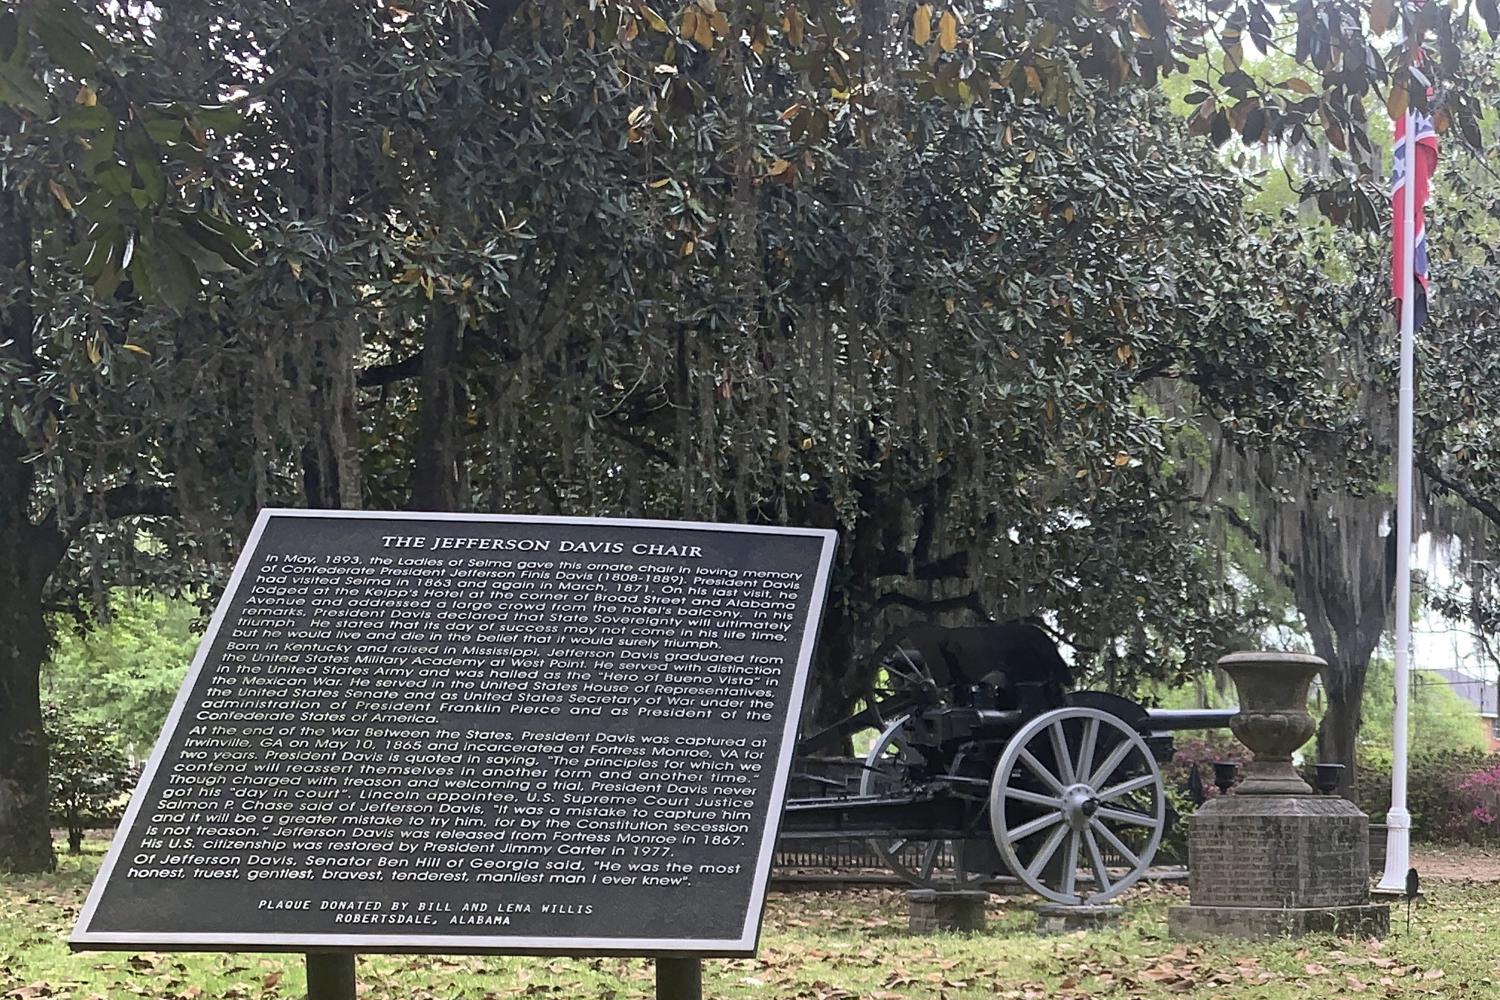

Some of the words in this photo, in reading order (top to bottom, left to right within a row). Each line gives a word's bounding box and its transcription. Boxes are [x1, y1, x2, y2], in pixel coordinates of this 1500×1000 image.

[382, 535, 426, 548] THE
[431, 537, 550, 551] JEFFERSON
[558, 540, 624, 554] DAVIS
[632, 543, 702, 557] CHAIR
[260, 564, 278, 573] of
[281, 564, 375, 575] Confederate
[380, 566, 446, 577] President
[449, 568, 516, 578] Jefferson
[520, 570, 551, 580] Finis
[555, 571, 593, 581] Davis
[693, 576, 758, 587] President
[762, 579, 800, 590] Davis
[265, 554, 279, 562] In
[369, 556, 393, 566] the
[398, 557, 444, 567] Ladies
[448, 558, 464, 567] of
[467, 558, 513, 568] Selma
[517, 561, 554, 572] gave
[559, 561, 582, 570] this
[586, 563, 634, 572] ornate
[638, 564, 675, 573] chair
[678, 565, 692, 575] in
[695, 566, 738, 578] loving
[742, 570, 803, 581] memory
[226, 641, 260, 651] Born
[264, 642, 279, 651] in
[284, 642, 353, 653] Kentucky
[356, 644, 388, 653] and
[392, 645, 440, 654] raised
[443, 645, 457, 655] in
[547, 648, 615, 658] Jefferson
[620, 649, 660, 660] Davis
[664, 652, 745, 664] graduated
[749, 654, 784, 664] from
[222, 653, 247, 662] the
[251, 653, 301, 663] United
[304, 653, 350, 664] States
[354, 655, 408, 666] Military
[411, 656, 486, 668] Academy
[489, 658, 506, 667] at
[511, 658, 545, 668] West
[593, 660, 614, 670] He
[618, 662, 669, 671] served
[673, 663, 702, 672] with
[706, 664, 781, 675] distinction
[196, 710, 295, 721] Confederate
[300, 711, 346, 722] States
[350, 712, 368, 722] of
[201, 699, 320, 709] administration
[329, 700, 348, 710] of
[355, 700, 431, 711] President
[439, 702, 501, 713] Franklin
[510, 704, 561, 714] Pierce
[569, 706, 602, 715] and
[610, 707, 629, 716] as
[638, 707, 712, 718] President
[720, 710, 737, 719] of
[746, 710, 772, 721] the
[188, 725, 208, 735] At
[211, 725, 237, 735] the
[242, 726, 275, 736] end
[278, 726, 297, 736] of
[300, 726, 325, 737] the
[331, 726, 360, 737] War
[364, 727, 430, 738] Between
[435, 729, 461, 739] the
[521, 731, 590, 742] President
[595, 732, 636, 743] Davis
[641, 735, 670, 744] was
[675, 736, 746, 747] captured
[750, 738, 767, 748] at
[145, 825, 159, 836] is
[162, 825, 191, 836] not
[272, 826, 346, 837] Jefferson
[352, 827, 395, 838] Davis
[400, 830, 431, 839] was
[435, 829, 506, 840] released
[510, 830, 547, 841] from
[552, 831, 611, 843] Fortress
[616, 833, 677, 844] Monroe
[682, 834, 696, 845] in
[140, 838, 164, 849] His
[202, 839, 286, 851] citizenship
[292, 841, 323, 850] was
[328, 841, 394, 851] restored
[398, 841, 419, 854] by
[423, 841, 495, 853] President
[499, 843, 553, 856] Jimmy
[557, 844, 606, 855] Carter
[611, 845, 625, 856] in
[133, 853, 157, 865] Of
[159, 854, 241, 865] Jefferson
[305, 855, 372, 867] Senator
[377, 856, 409, 867] Ben
[415, 857, 441, 868] Hill
[446, 857, 465, 868] of
[470, 858, 539, 871] Georgia
[628, 863, 660, 872] was
[666, 862, 693, 873] the
[699, 864, 741, 874] most
[476, 872, 544, 883] manliest
[549, 874, 586, 884] man
[601, 875, 637, 885] ever
[258, 899, 311, 910] PLAQUE
[320, 900, 382, 911] DONATED
[390, 901, 409, 911] BY
[417, 902, 452, 912] BILL
[461, 902, 488, 912] AND
[497, 903, 531, 913] LENA
[541, 904, 593, 914] WILLIS
[449, 915, 510, 925] ALABAMA
